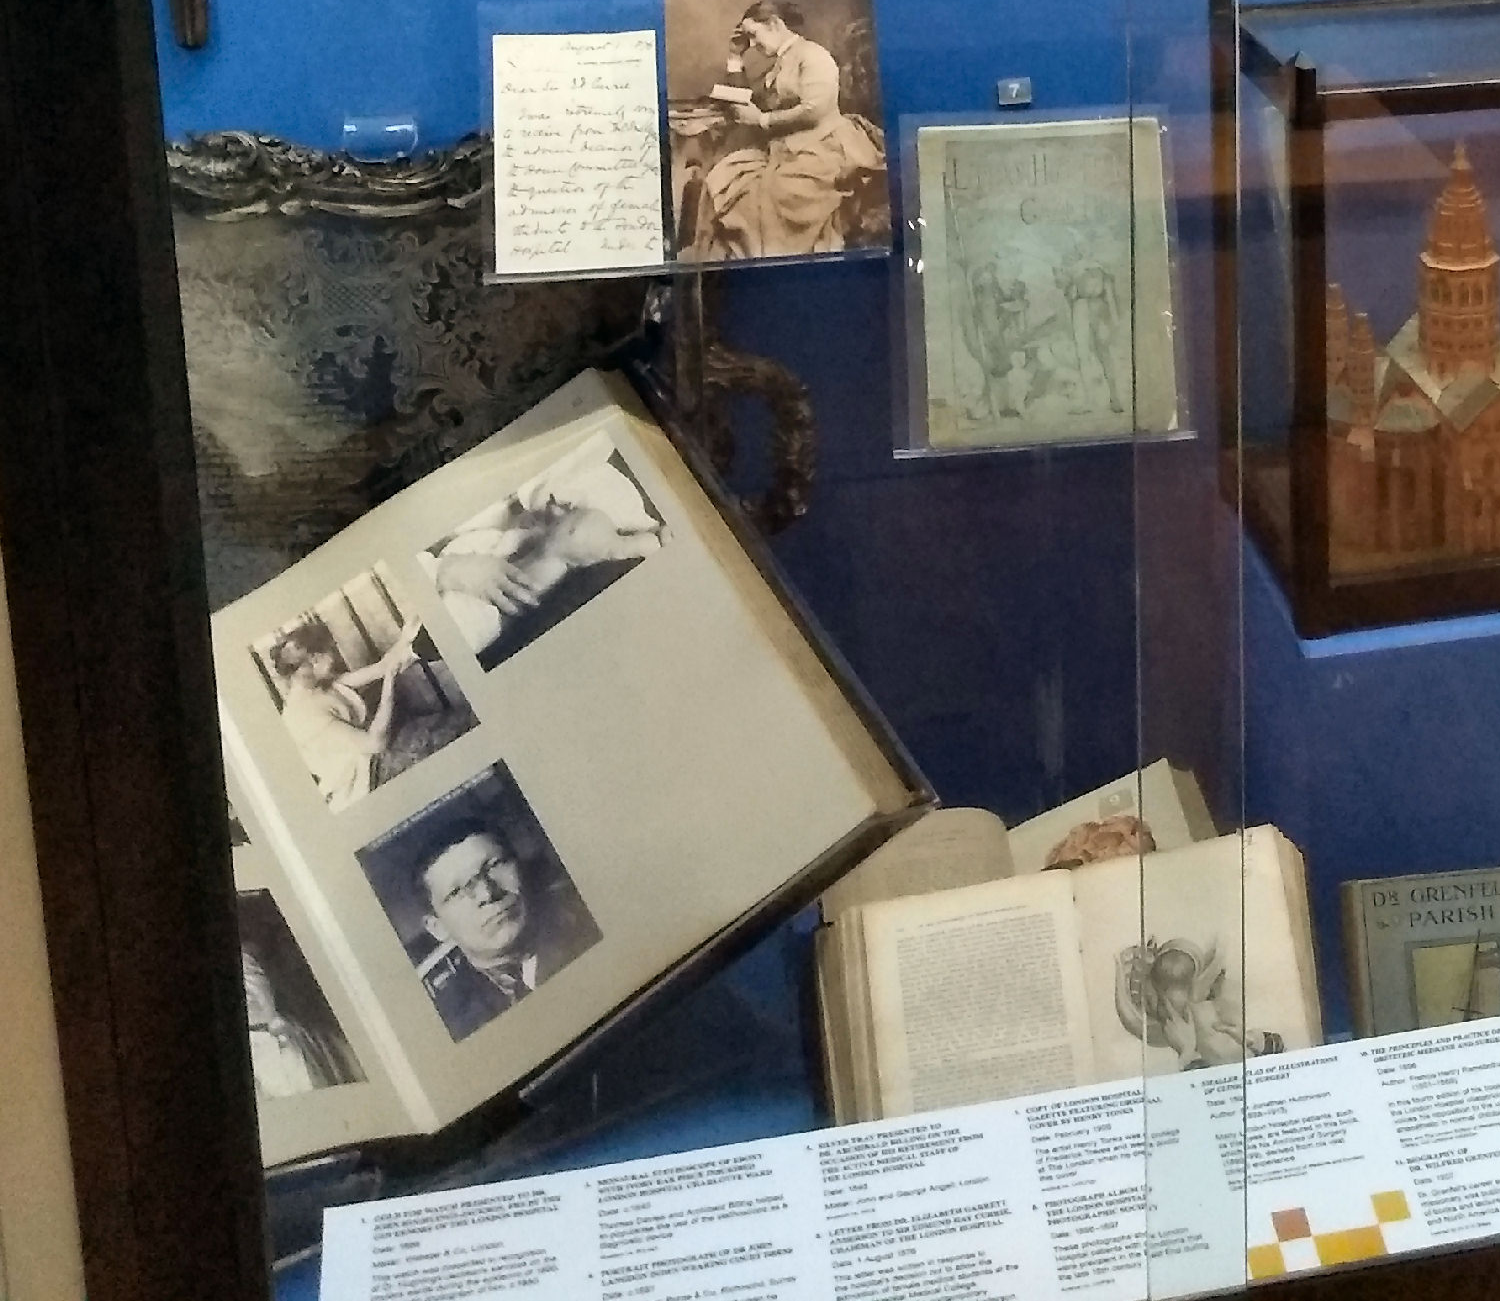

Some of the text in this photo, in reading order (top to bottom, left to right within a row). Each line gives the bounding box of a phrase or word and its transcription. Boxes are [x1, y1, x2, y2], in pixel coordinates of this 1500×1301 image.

[1008, 84, 1020, 98] 7
[1410, 905, 1493, 927] PARISH
[1436, 1037, 1451, 1045] AND
[1453, 1031, 1489, 1042] PRACTICE
[1491, 1028, 1500, 1036] OF
